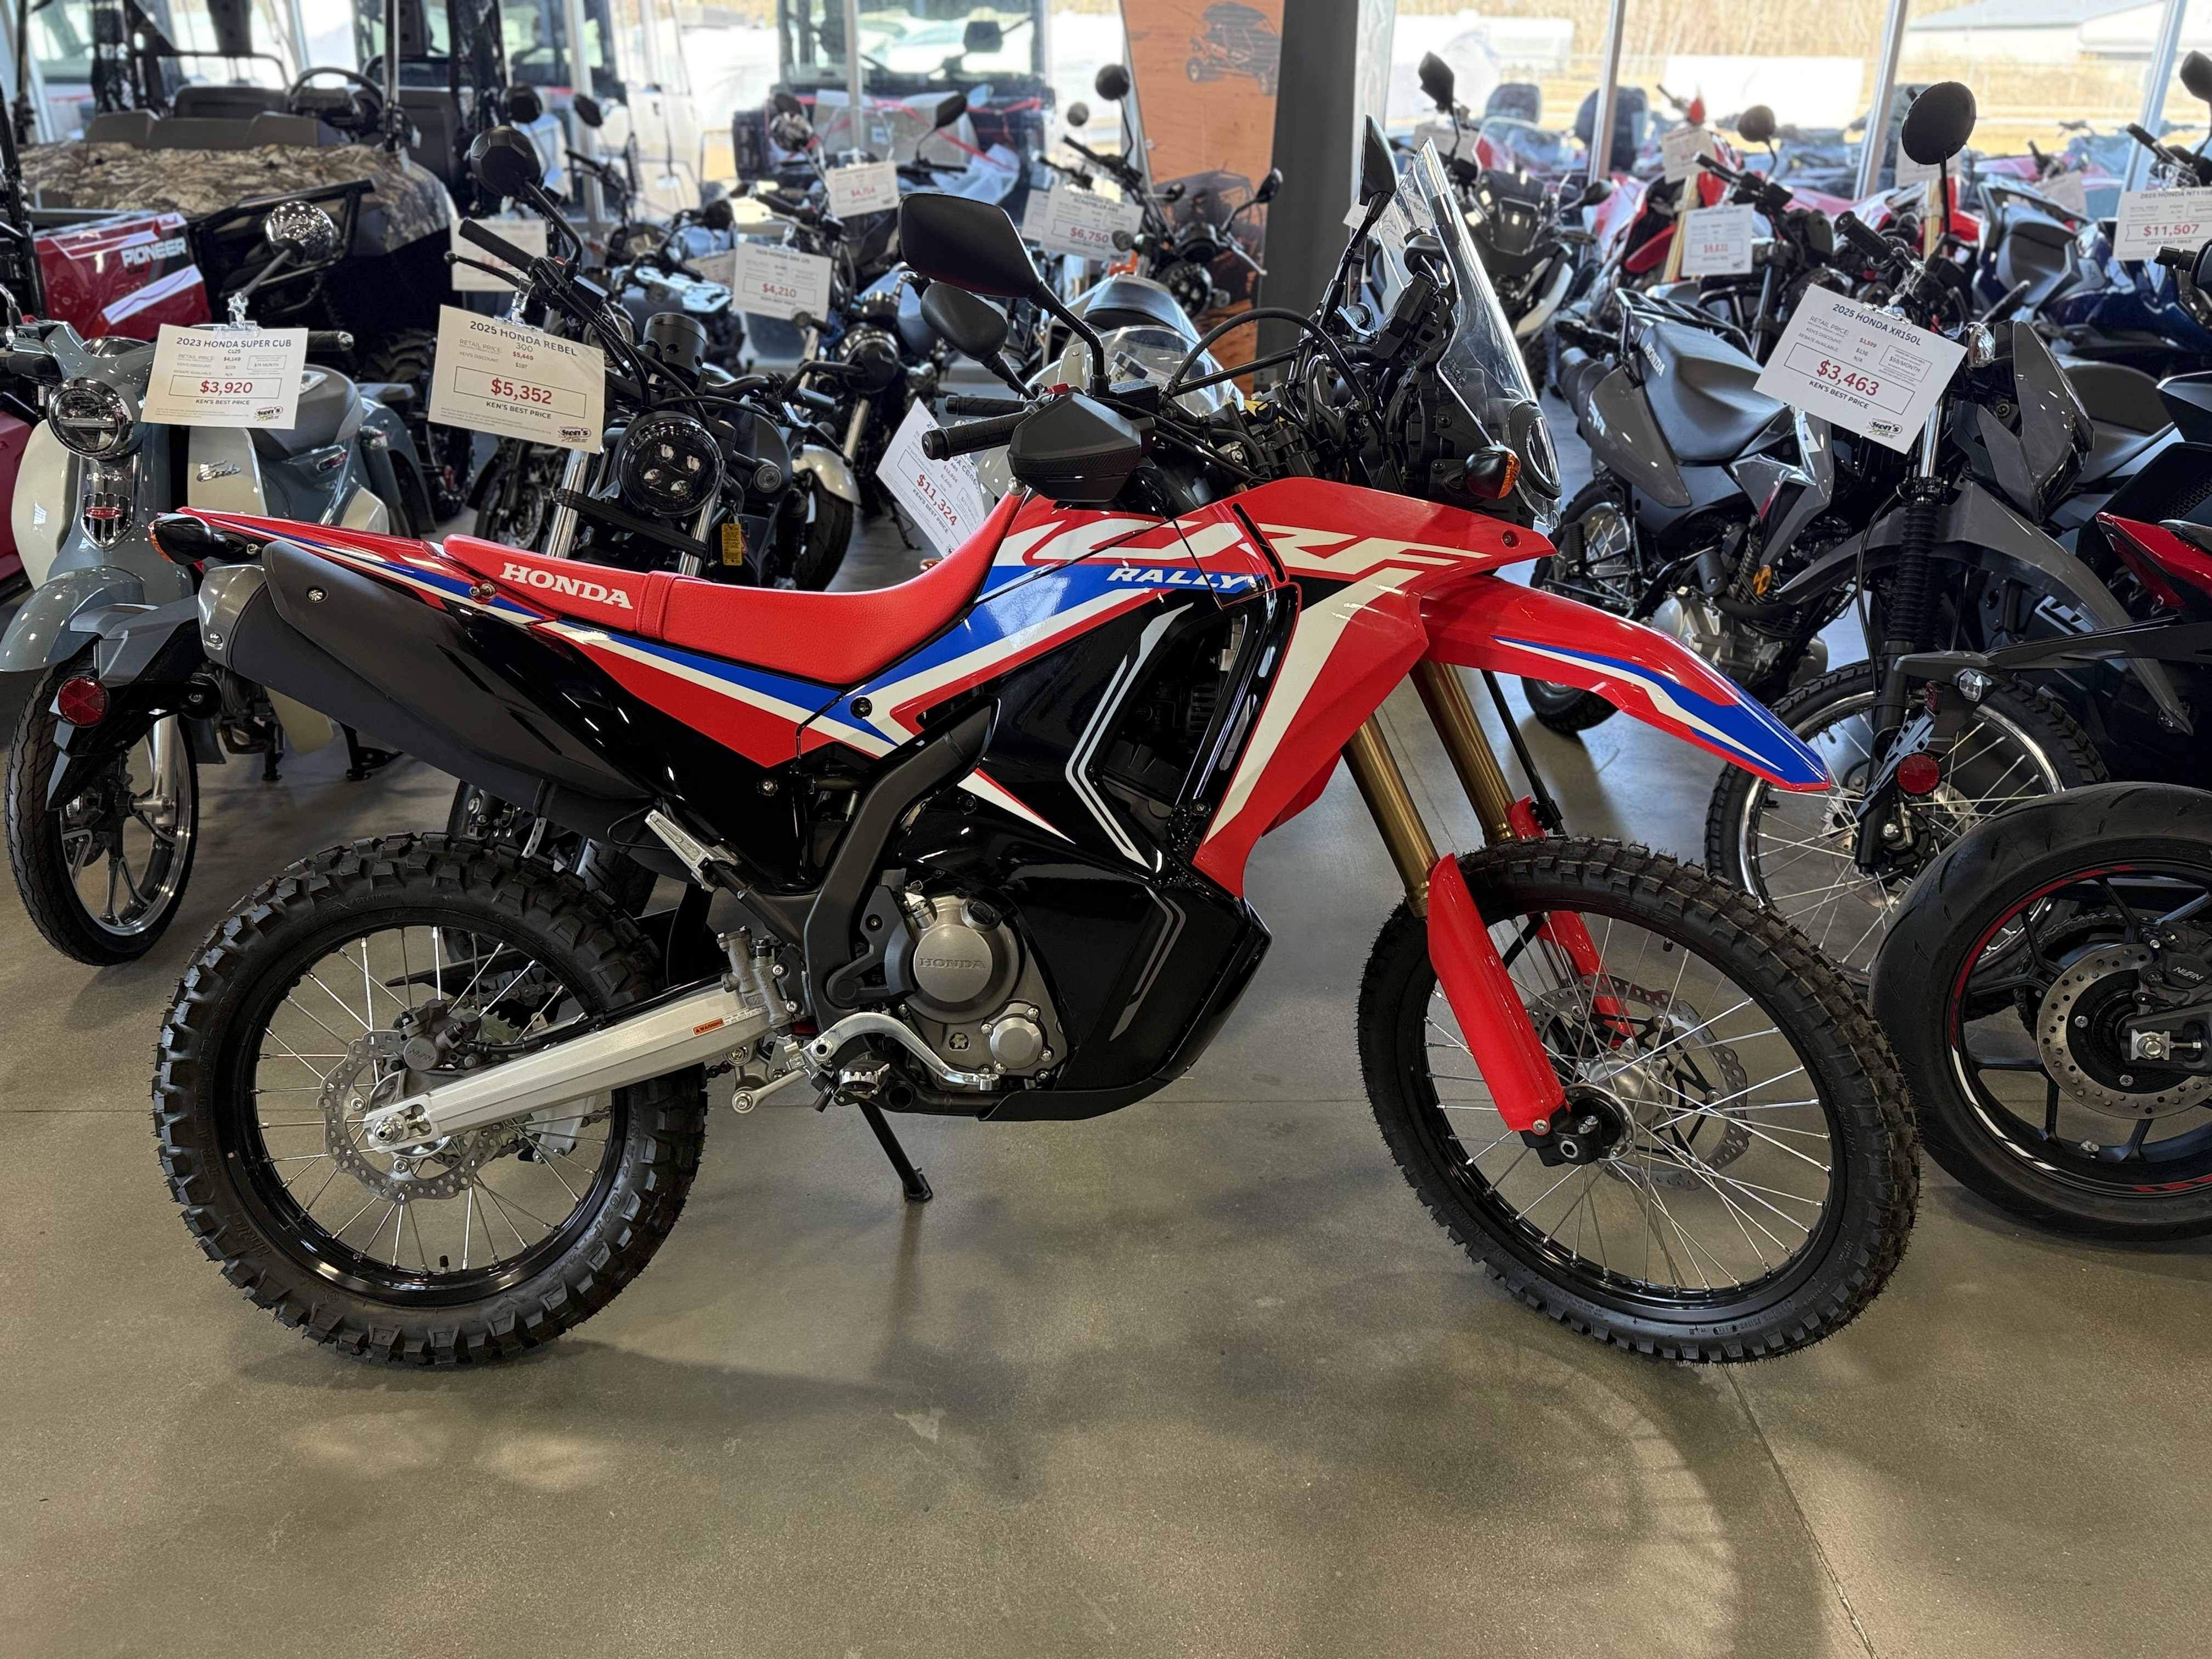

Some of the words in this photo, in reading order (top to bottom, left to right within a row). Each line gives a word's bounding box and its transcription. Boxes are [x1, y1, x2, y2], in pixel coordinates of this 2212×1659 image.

[1070, 227, 1109, 244] $6,750
[2143, 224, 2199, 237] $11,507
[120, 236, 187, 268] PIONEER
[762, 283, 797, 298] $4,210
[1809, 315, 1830, 329] RETAIL
[1831, 303, 1855, 318] 2025
[1855, 313, 1888, 332] HONDA
[1888, 328, 1923, 347] XR150L
[177, 337, 201, 347] 2023
[204, 340, 238, 348] HONDA
[240, 340, 270, 348] SUPER
[272, 339, 291, 347] CUB
[459, 338, 481, 348] RETAIL
[470, 320, 498, 335] 2025
[500, 329, 540, 347] HONDA
[543, 340, 578, 357] REBEL
[515, 342, 533, 353] 300
[1643, 341, 1666, 377] HONDA
[199, 380, 253, 396] $3,920
[1816, 359, 1880, 396] $3,463
[490, 377, 552, 405] $5,352
[1808, 380, 1830, 393] KEN'S
[1829, 388, 1849, 401] BEST
[1847, 396, 1870, 410] PRICE
[486, 401, 508, 411] KEN'S
[509, 405, 528, 415] BEST
[529, 409, 552, 420] PRICE
[912, 488, 926, 505] KEN'S
[925, 503, 938, 518] BEST
[936, 516, 949, 534] PRICE
[917, 474, 958, 527] $11,324
[499, 562, 634, 610] HONDA
[1106, 566, 1251, 591] RALLY
[919, 957, 988, 970] HONDA
[699, 1020, 724, 1032] WARNING
[194, 1080, 221, 1179] TRAILS
